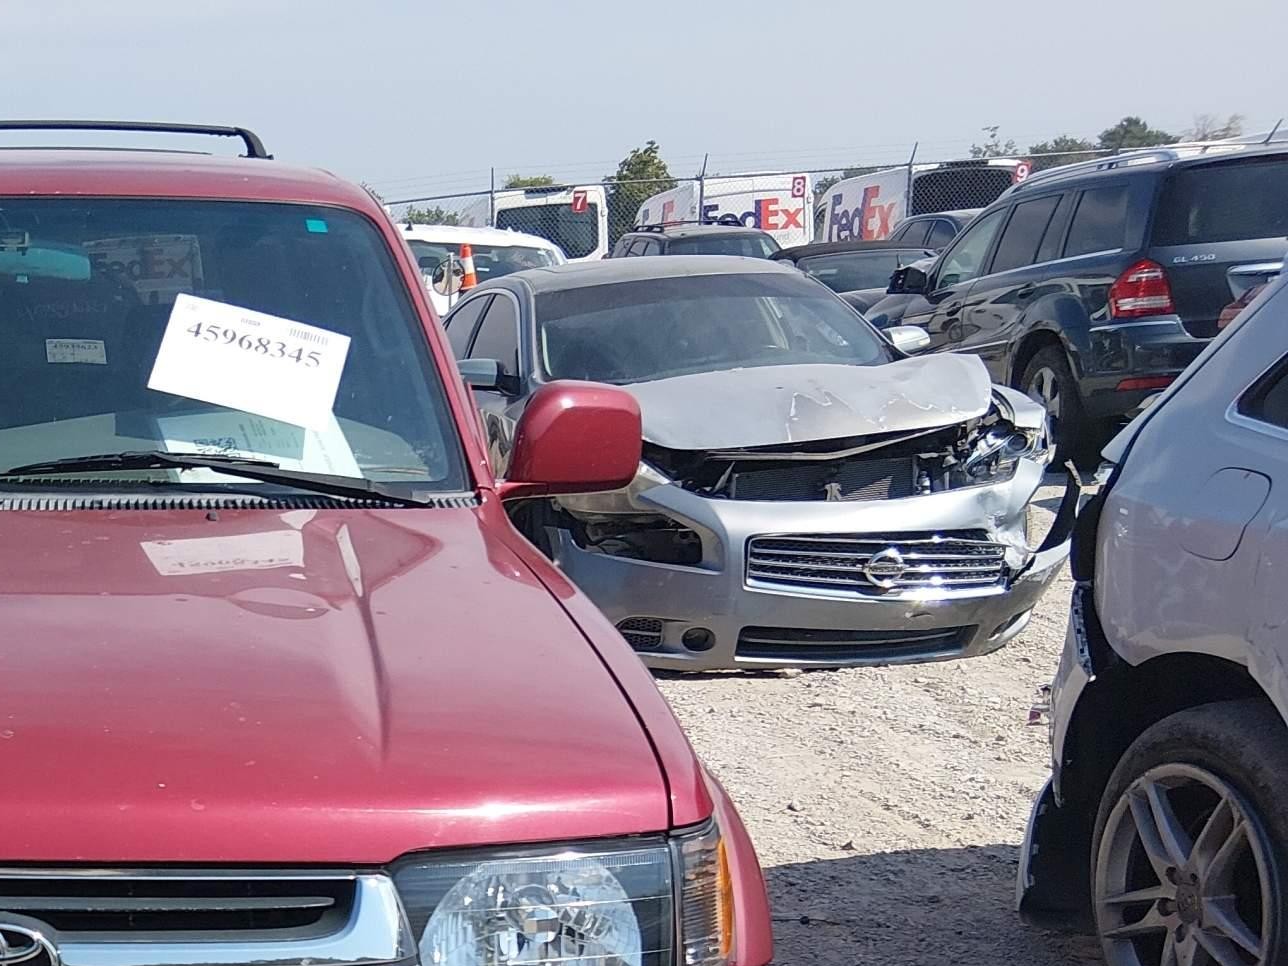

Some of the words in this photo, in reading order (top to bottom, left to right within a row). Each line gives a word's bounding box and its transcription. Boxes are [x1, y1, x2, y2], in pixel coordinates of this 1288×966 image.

[1017, 165, 1028, 182] 9
[794, 179, 804, 196] 8
[574, 193, 585, 210] 7
[830, 186, 895, 241] FedEx
[186, 321, 323, 369] 45968345
